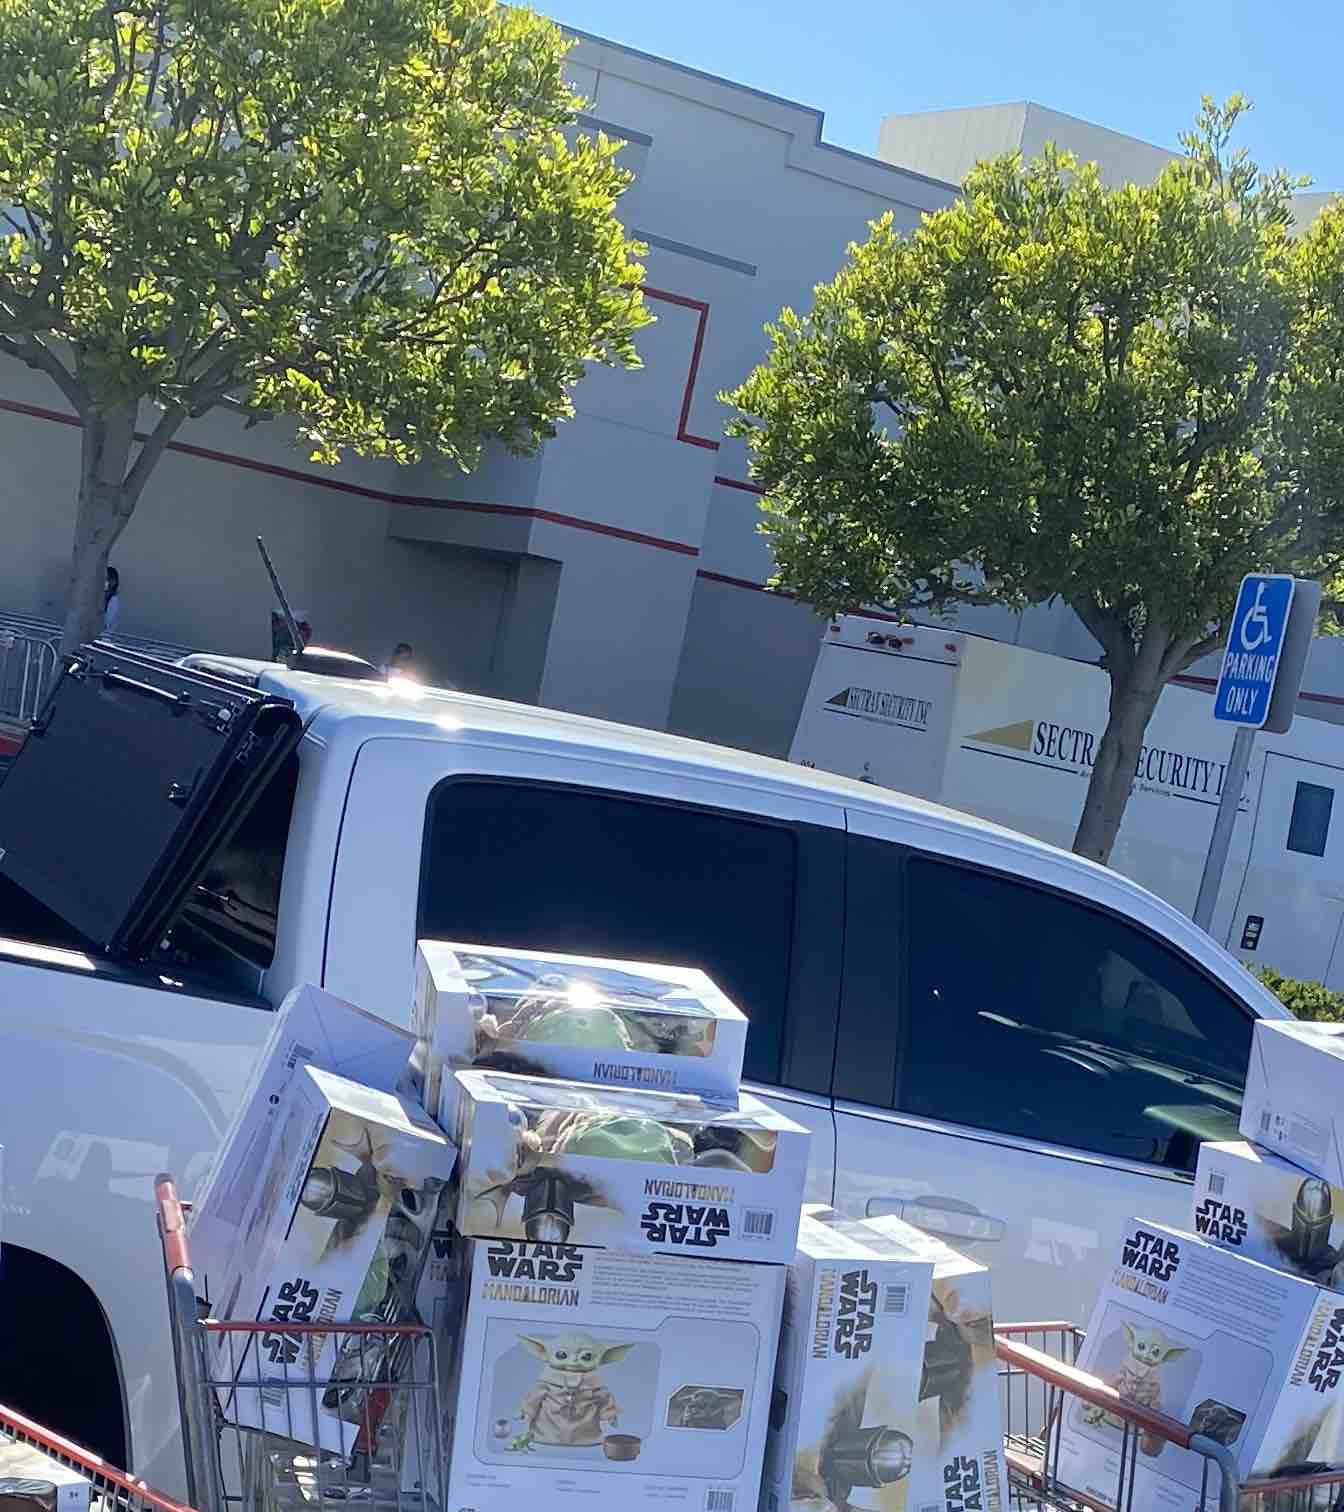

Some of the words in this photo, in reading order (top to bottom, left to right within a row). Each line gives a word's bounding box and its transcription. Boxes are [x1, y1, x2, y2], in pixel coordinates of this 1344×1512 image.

[1224, 651, 1275, 683] PARKING
[1226, 687, 1259, 717] ONLY
[1035, 721, 1095, 767] SECTR
[1135, 747, 1216, 793] ECURITY
[593, 1062, 676, 1085] MANDALORIAN
[644, 1179, 734, 1202] MANDALORIAN
[642, 1202, 730, 1228] WARS
[1195, 1198, 1248, 1229] STAR
[640, 1221, 730, 1247] STAR
[1195, 1214, 1248, 1246] WARS
[1125, 1230, 1180, 1264] STAR
[488, 1256, 583, 1281] WARS
[1121, 1246, 1178, 1282] WARS
[482, 1283, 579, 1306] MANDALORIAN
[834, 1271, 861, 1359] WARS
[853, 1270, 878, 1359] STAR
